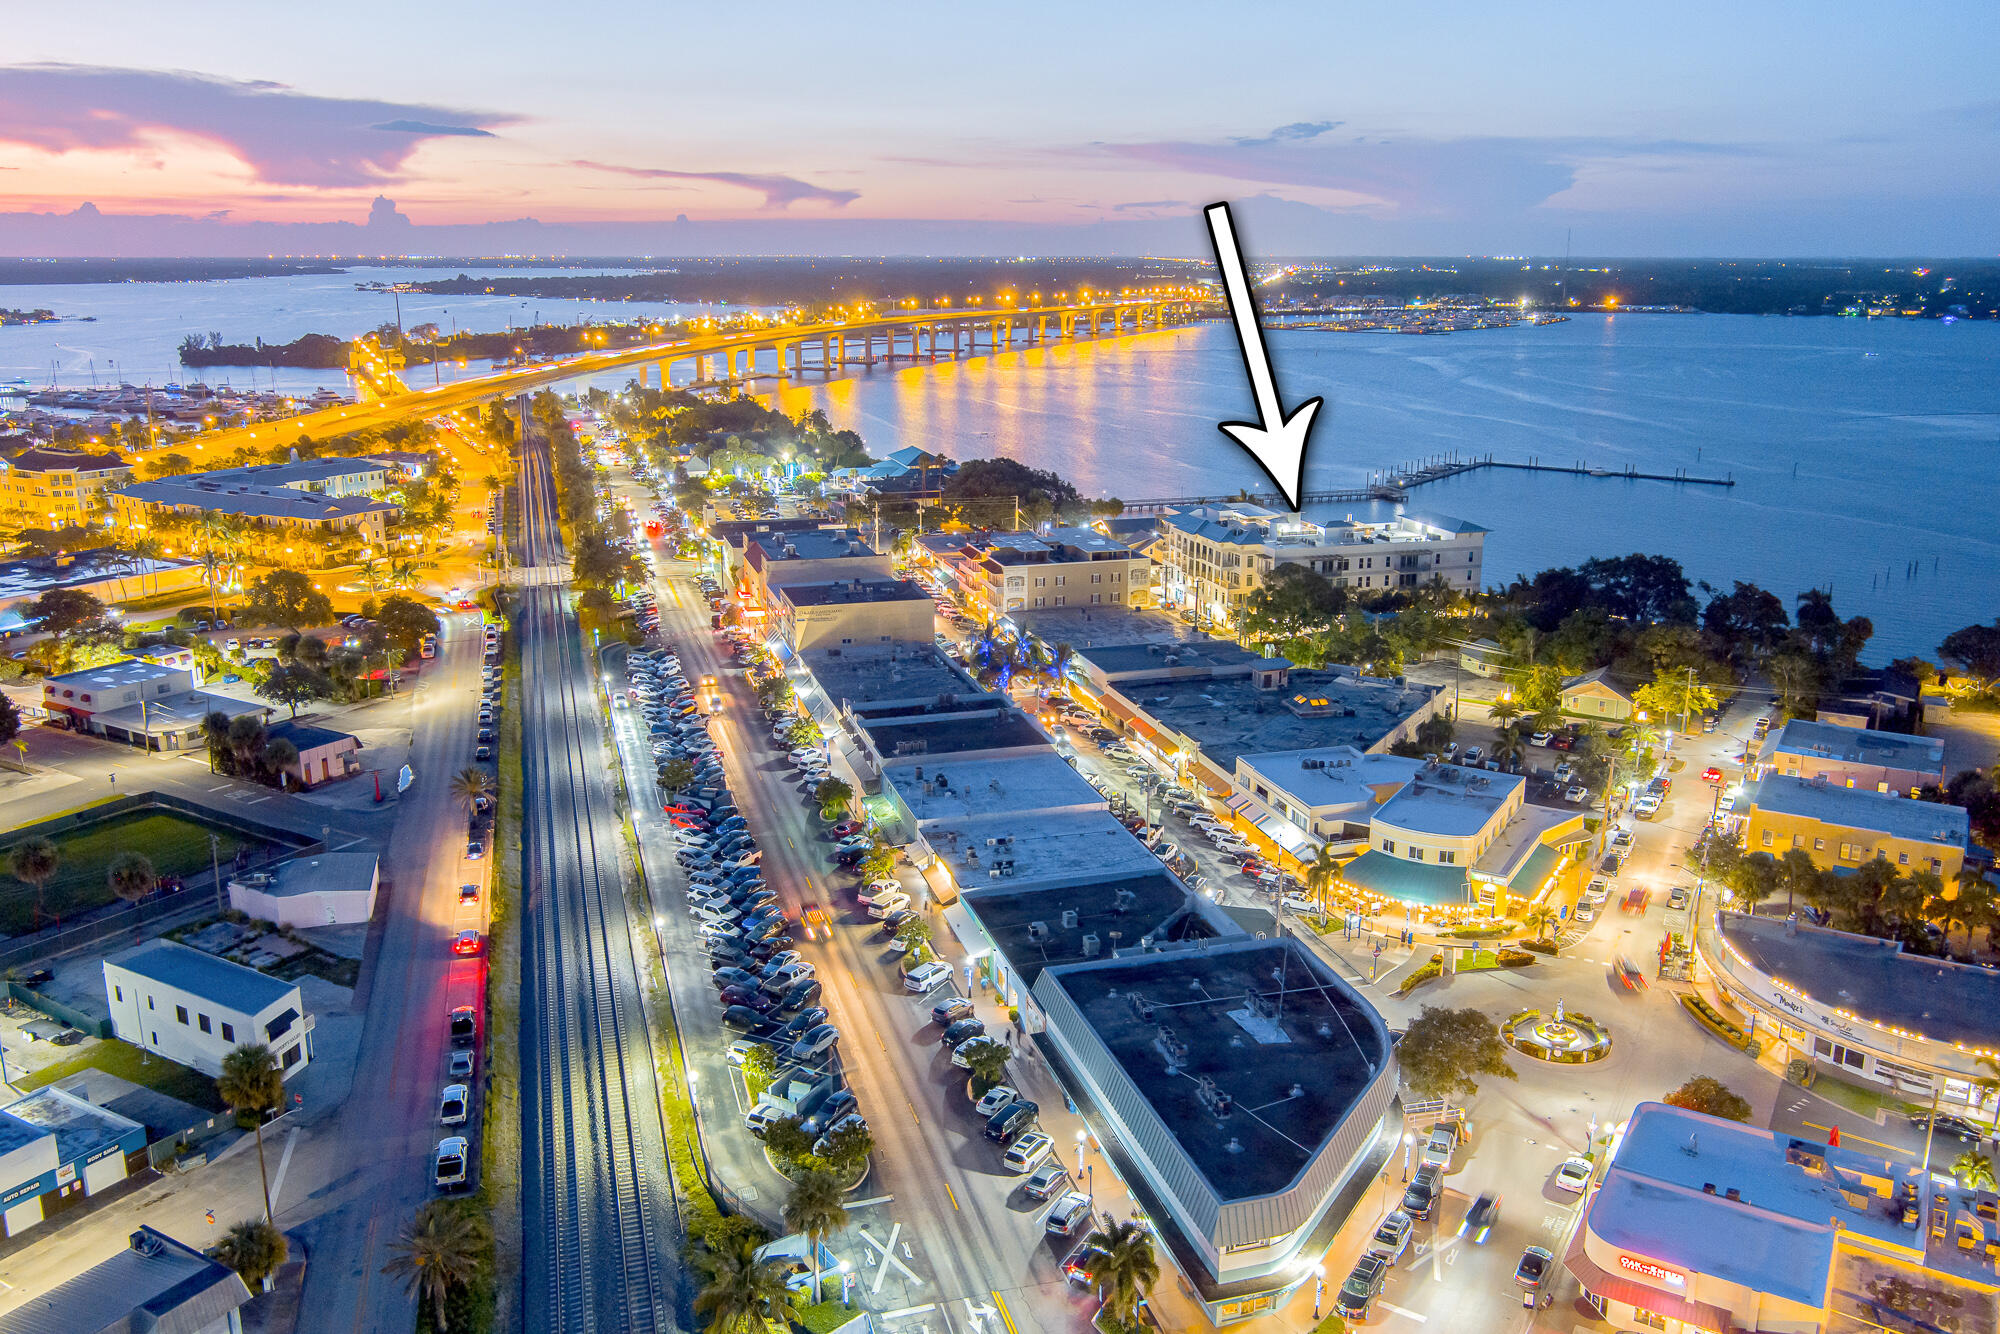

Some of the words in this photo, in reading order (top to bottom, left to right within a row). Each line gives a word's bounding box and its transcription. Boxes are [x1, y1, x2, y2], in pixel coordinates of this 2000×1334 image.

[87, 1151, 103, 1164] BODY
[103, 1144, 119, 1156] SHOP
[3, 1191, 19, 1204] AUTO
[19, 1181, 40, 1196] REPAIR
[1620, 1256, 1641, 1268] OAK
